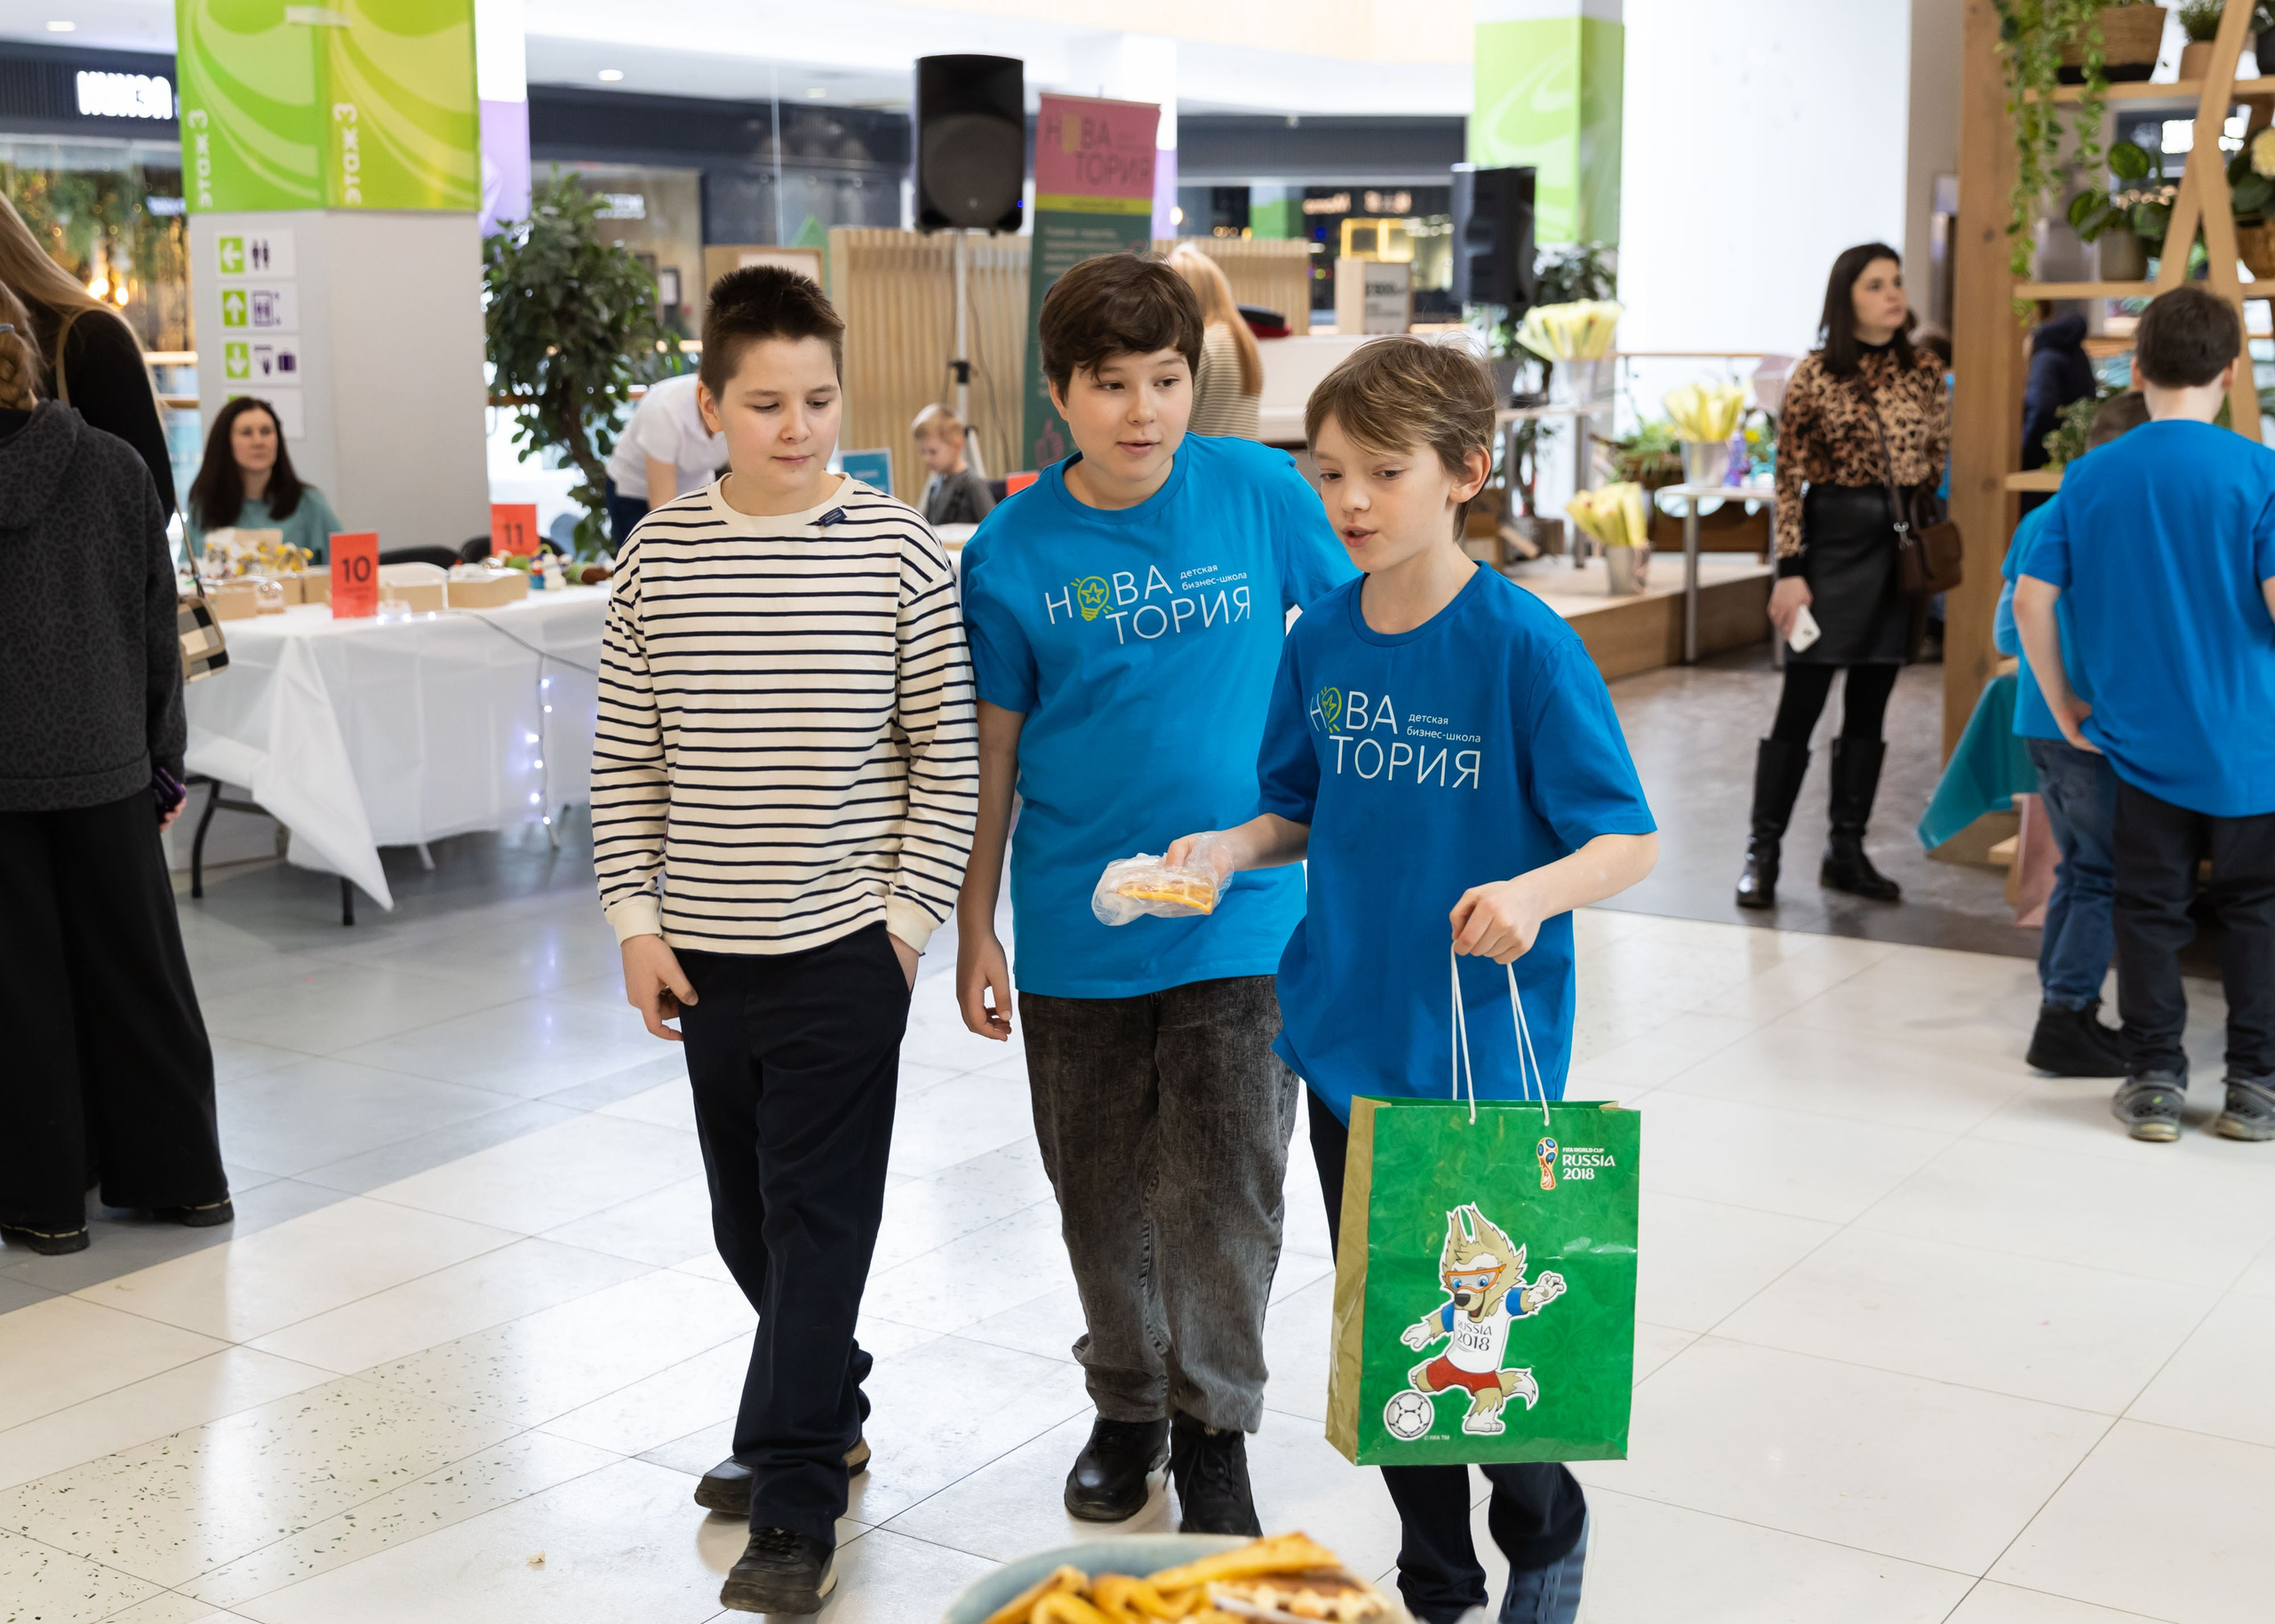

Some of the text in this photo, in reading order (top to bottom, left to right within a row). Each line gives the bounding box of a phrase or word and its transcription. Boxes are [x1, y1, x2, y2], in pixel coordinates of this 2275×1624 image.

[187, 108, 209, 129] 3
[332, 102, 357, 123] 3
[1074, 150, 1153, 187] ТОРИЯ
[504, 522, 523, 545] 11
[341, 555, 371, 584] 10
[1179, 564, 1218, 579] детская
[1181, 571, 1248, 591] бизнес-школа
[1106, 585, 1250, 645] ТОРИЯ
[1408, 713, 1449, 725] детская
[1406, 726, 1481, 743] бизнес-школа
[1329, 735, 1481, 790] ТОРИЯ
[1562, 1154, 1616, 1166] RUSSIA
[1562, 1167, 1595, 1180] 2018
[1457, 1330, 1489, 1351] 2018
